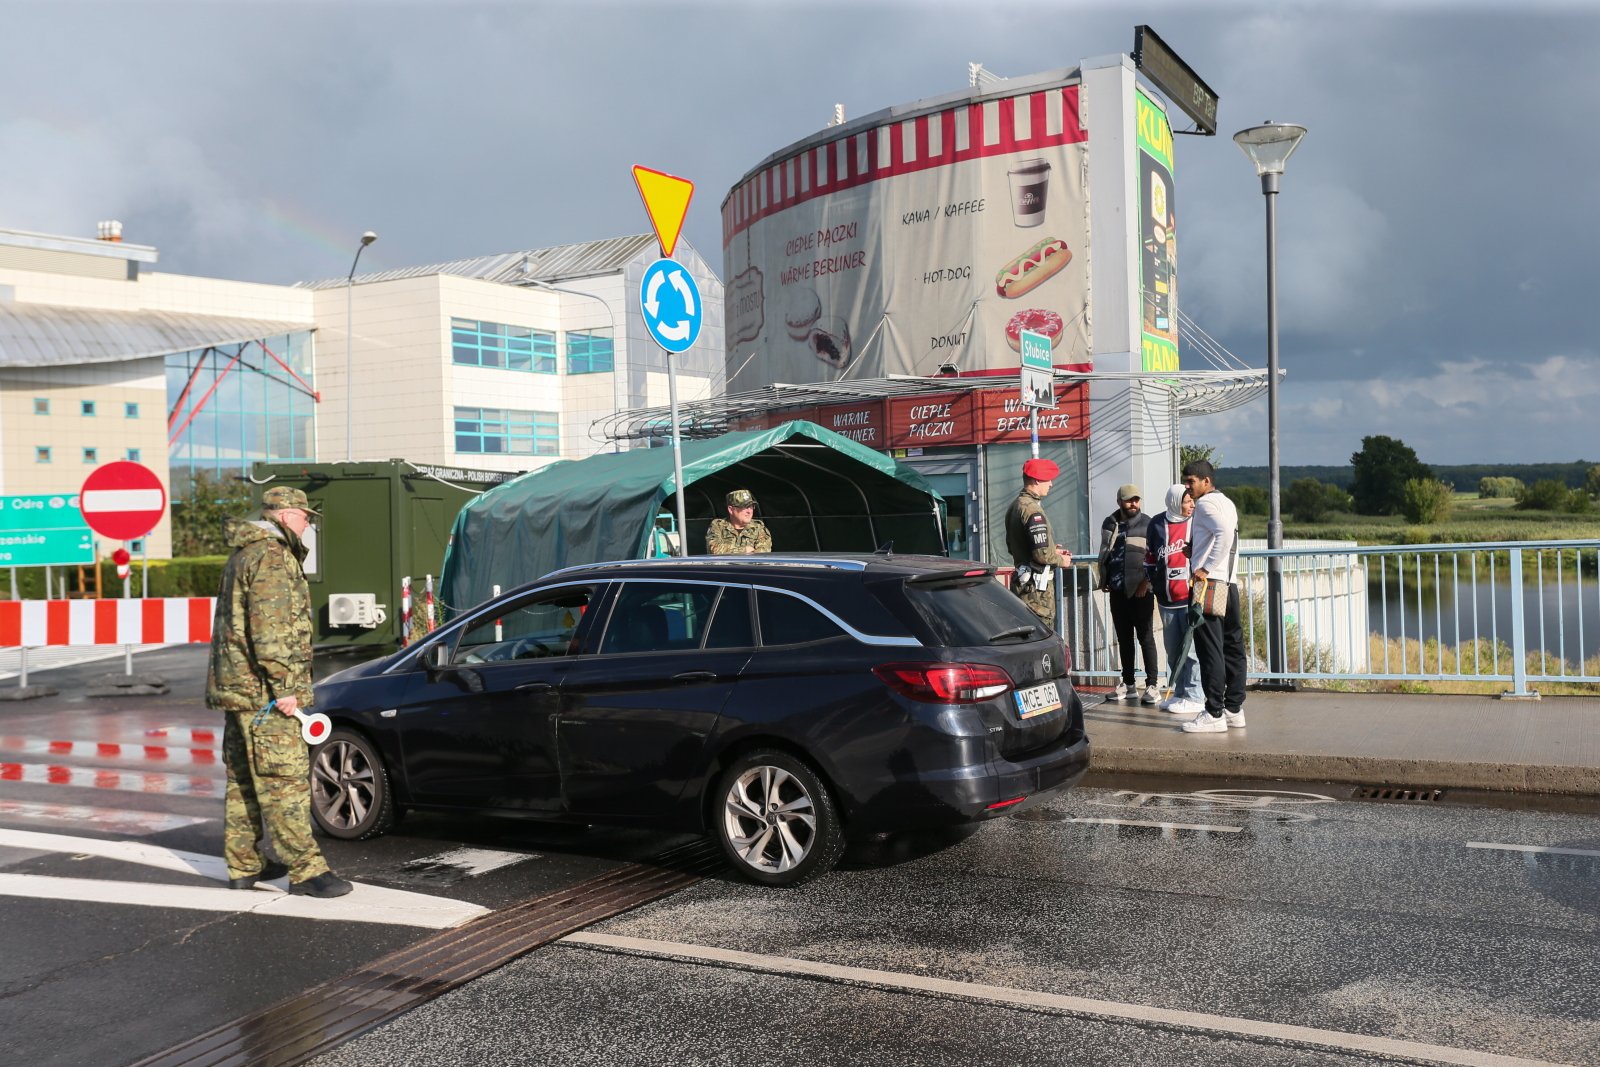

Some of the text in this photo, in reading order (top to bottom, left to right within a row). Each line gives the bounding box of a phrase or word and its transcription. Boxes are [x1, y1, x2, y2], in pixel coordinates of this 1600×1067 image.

[902, 198, 985, 225] KAWA / KAFFEE
[786, 222, 858, 256] CIEPŁE PĄCZKI
[781, 250, 866, 286] WÄRME BERLINER
[923, 265, 971, 284] HOT-DOG
[931, 332, 967, 349] DONUT
[1024, 340, 1050, 362] Słubice
[833, 411, 871, 427] WARME
[910, 403, 953, 420] CIEPŁE
[909, 421, 955, 440] PĄCZKI
[435, 467, 464, 480] GRANICZNA
[468, 470, 485, 482] POLISH
[1033, 533, 1047, 544] MP
[1021, 689, 1042, 711] MCE
[1043, 685, 1059, 704] 062
